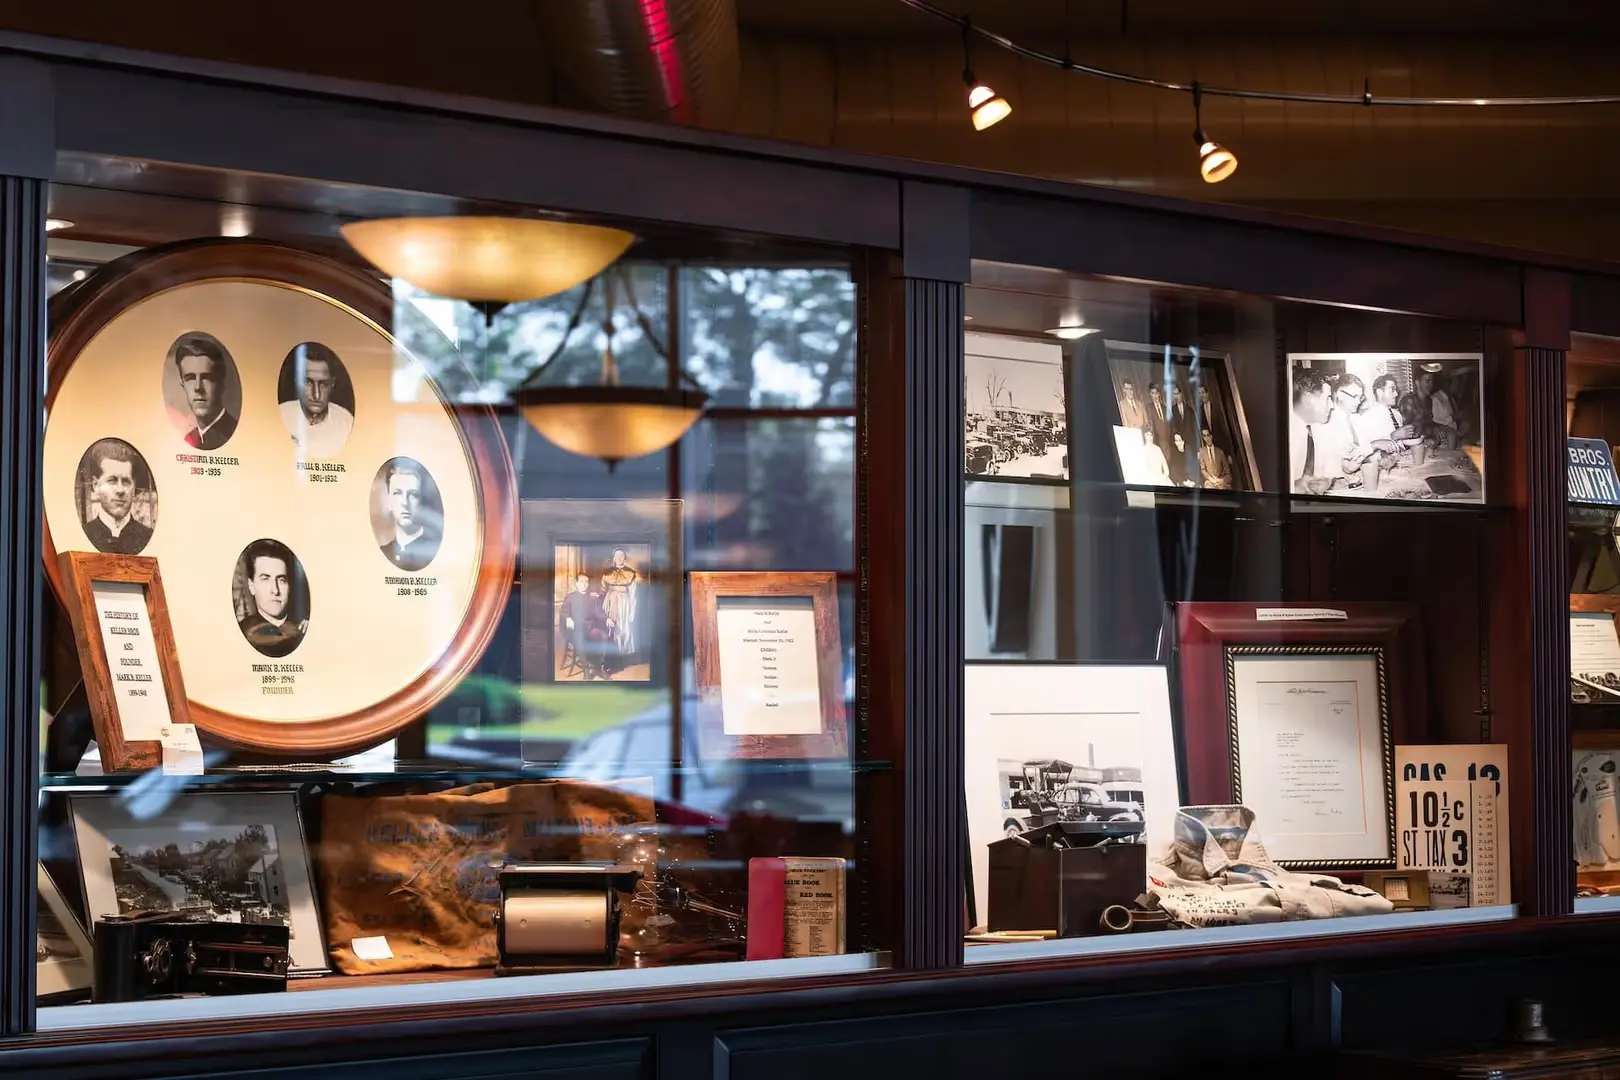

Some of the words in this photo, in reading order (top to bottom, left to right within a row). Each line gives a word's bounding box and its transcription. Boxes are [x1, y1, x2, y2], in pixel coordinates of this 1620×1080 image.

[1568, 447, 1610, 466] BROS.
[1568, 466, 1618, 500] OUNTRY
[281, 664, 304, 672] KELLER
[1425, 830, 1447, 867] TAX
[1452, 830, 1468, 867] 3
